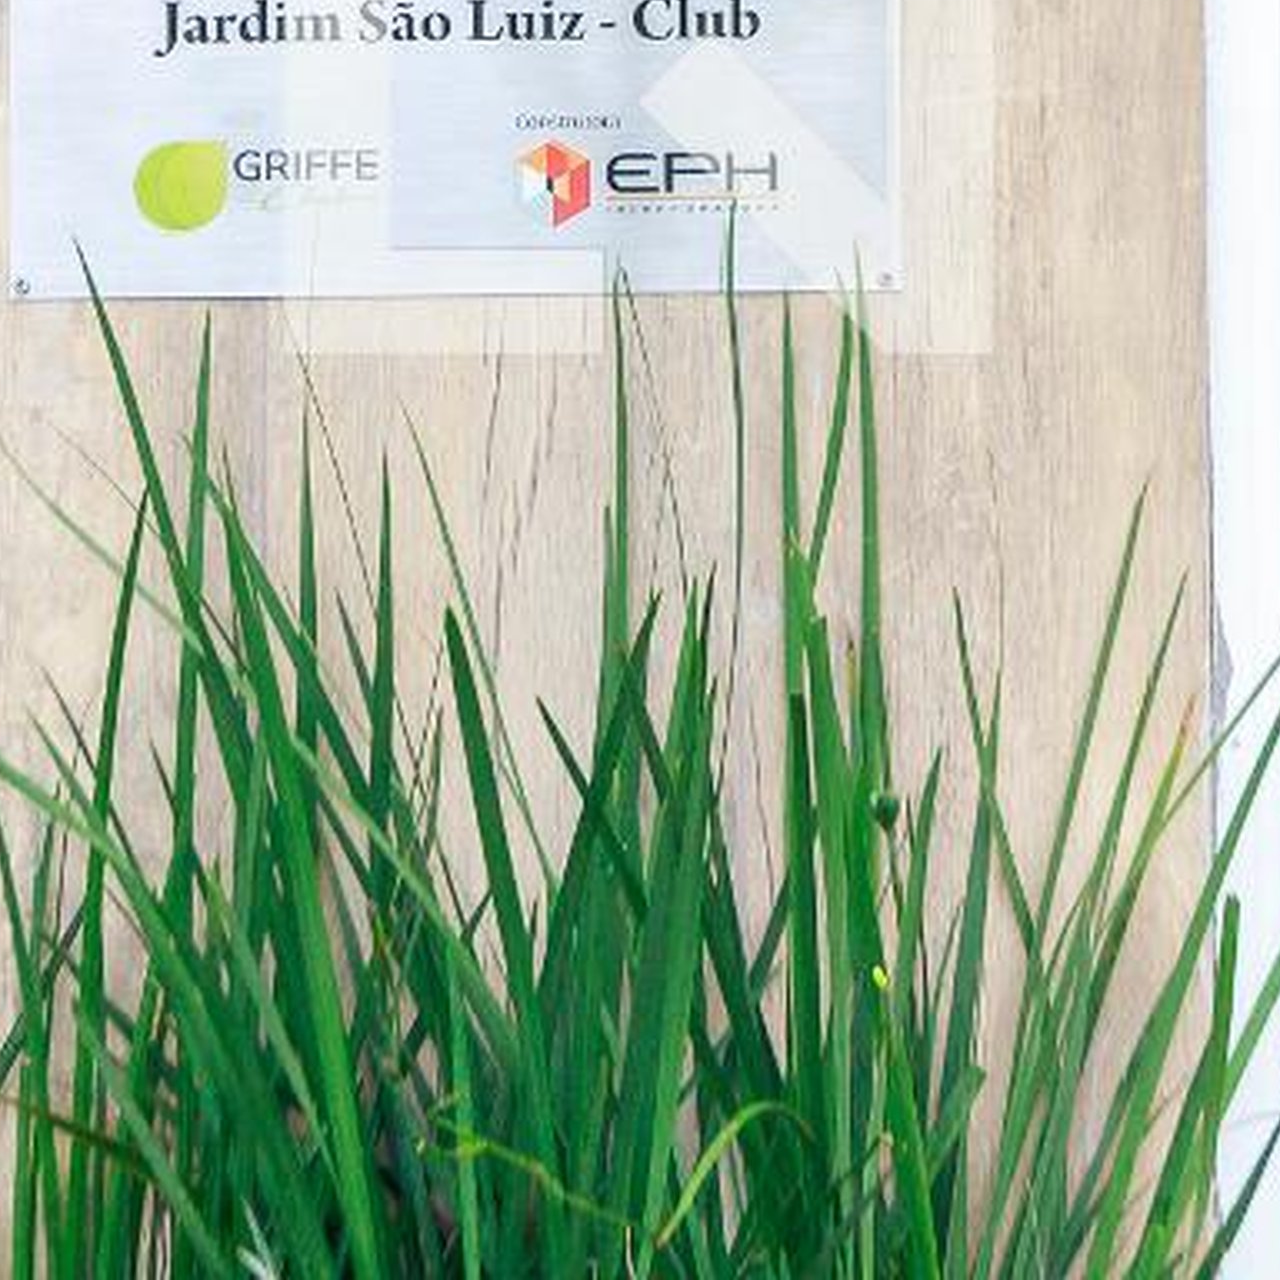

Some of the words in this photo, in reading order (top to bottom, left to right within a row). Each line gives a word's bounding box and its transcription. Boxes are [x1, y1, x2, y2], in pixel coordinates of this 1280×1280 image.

[467, 0, 586, 41] Luiz
[232, 148, 380, 182] GRIFFE
[606, 150, 778, 193] EPH
